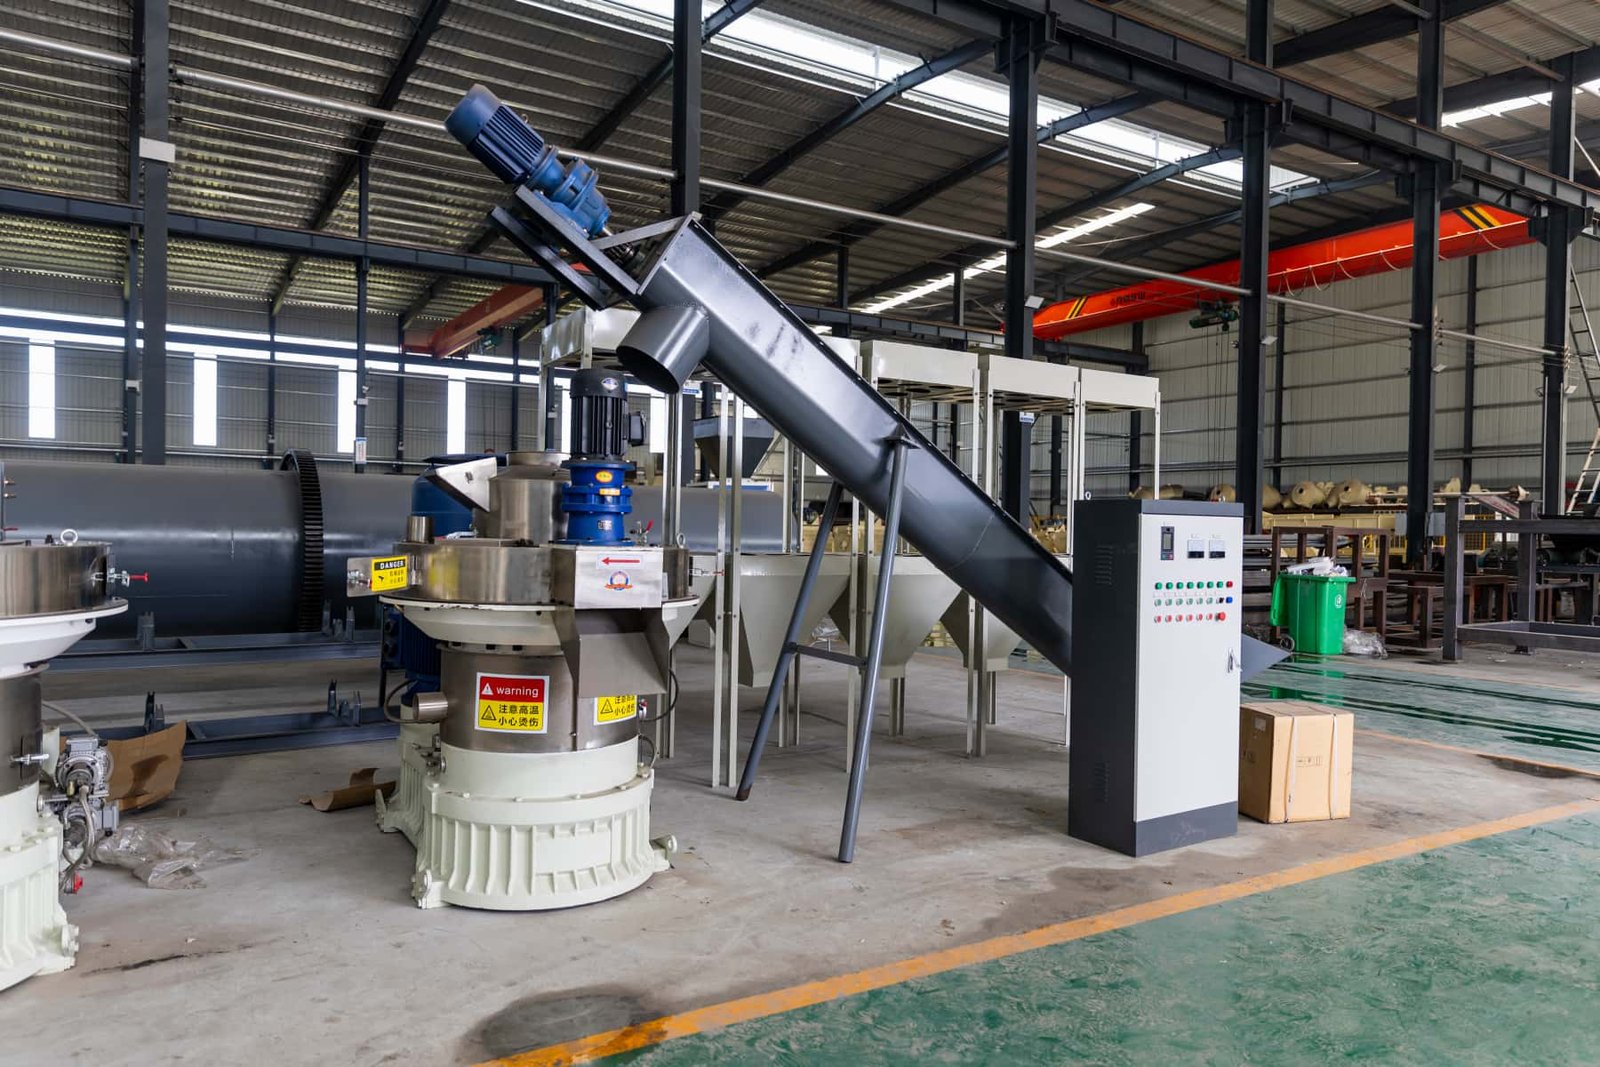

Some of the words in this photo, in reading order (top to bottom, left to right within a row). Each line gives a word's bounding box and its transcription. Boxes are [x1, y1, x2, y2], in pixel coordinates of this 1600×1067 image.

[380, 560, 404, 569] DANGER
[496, 686, 539, 698] warning
[499, 704, 539, 715] 注意高温
[499, 716, 539, 727] 小心烫伤
